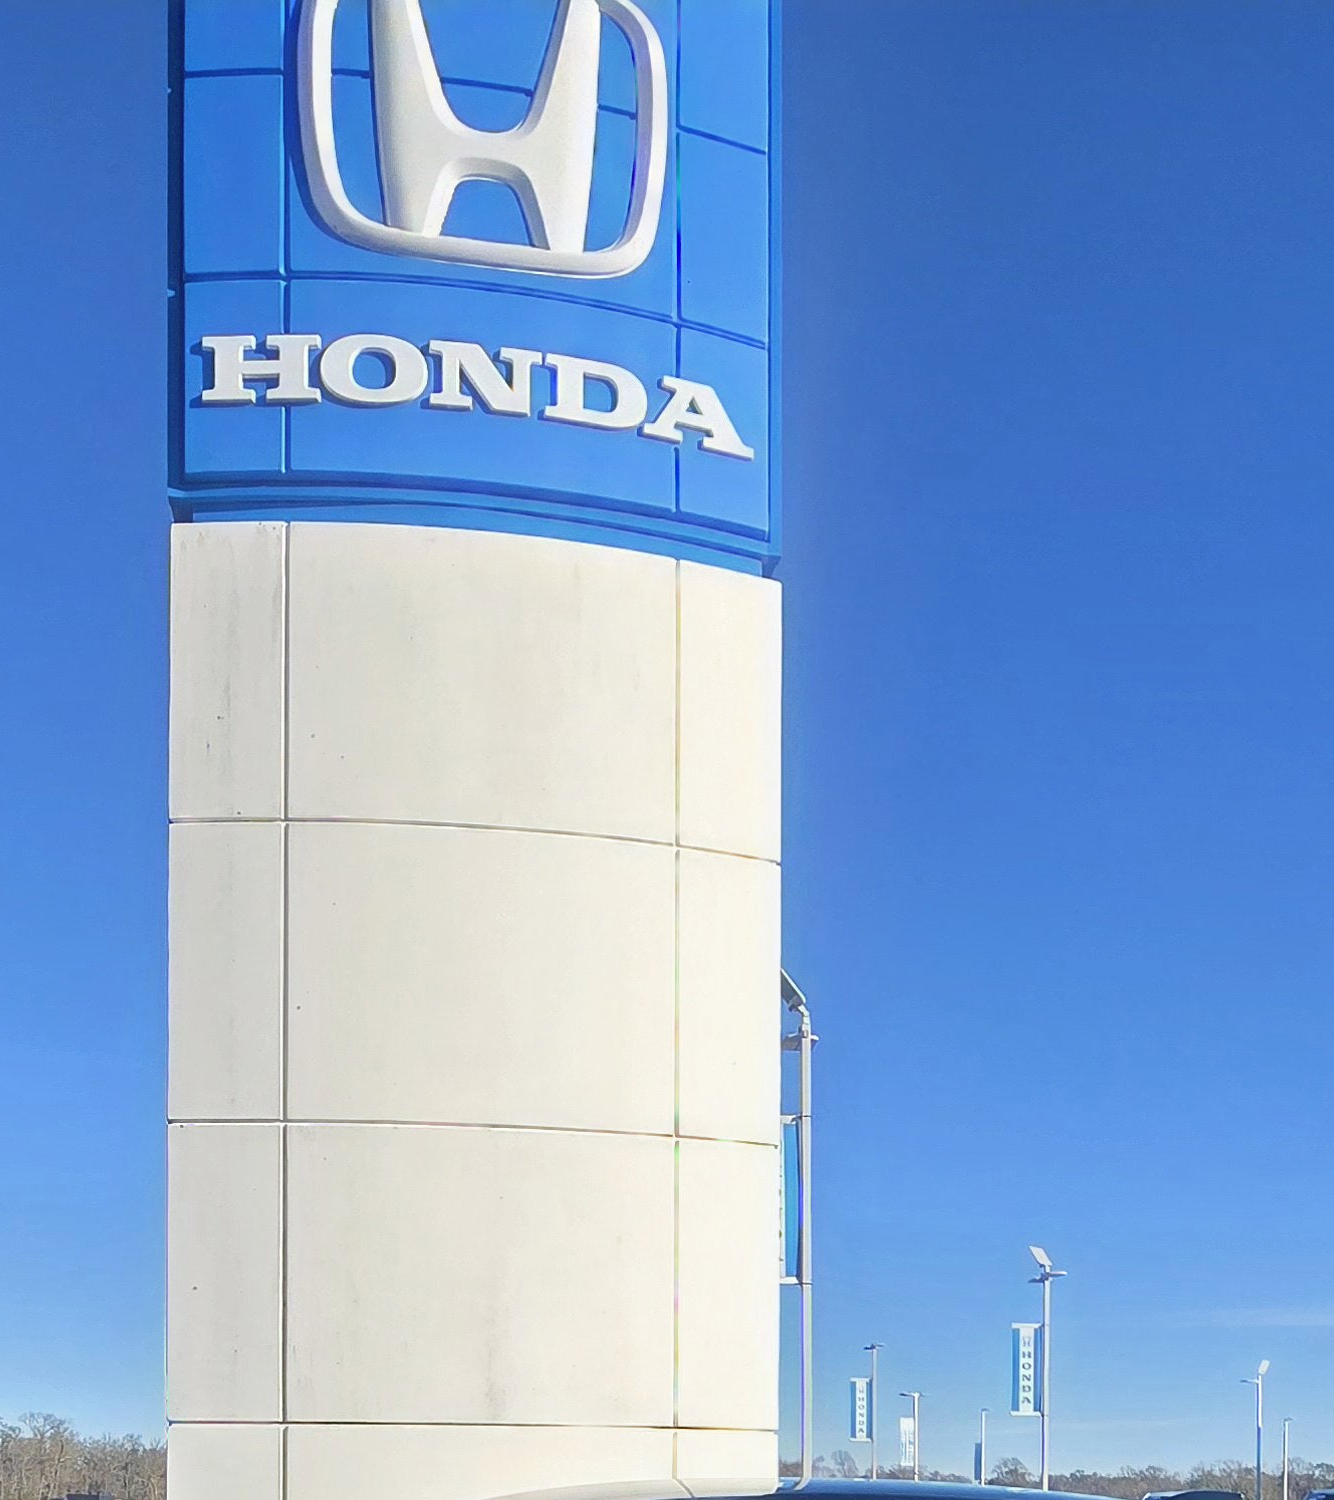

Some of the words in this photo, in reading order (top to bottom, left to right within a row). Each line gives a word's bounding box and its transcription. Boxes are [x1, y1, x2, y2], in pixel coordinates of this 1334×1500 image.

[201, 333, 755, 461] HONDA
[1021, 1350, 1033, 1405] HONDA
[858, 1396, 866, 1434] HONDA
